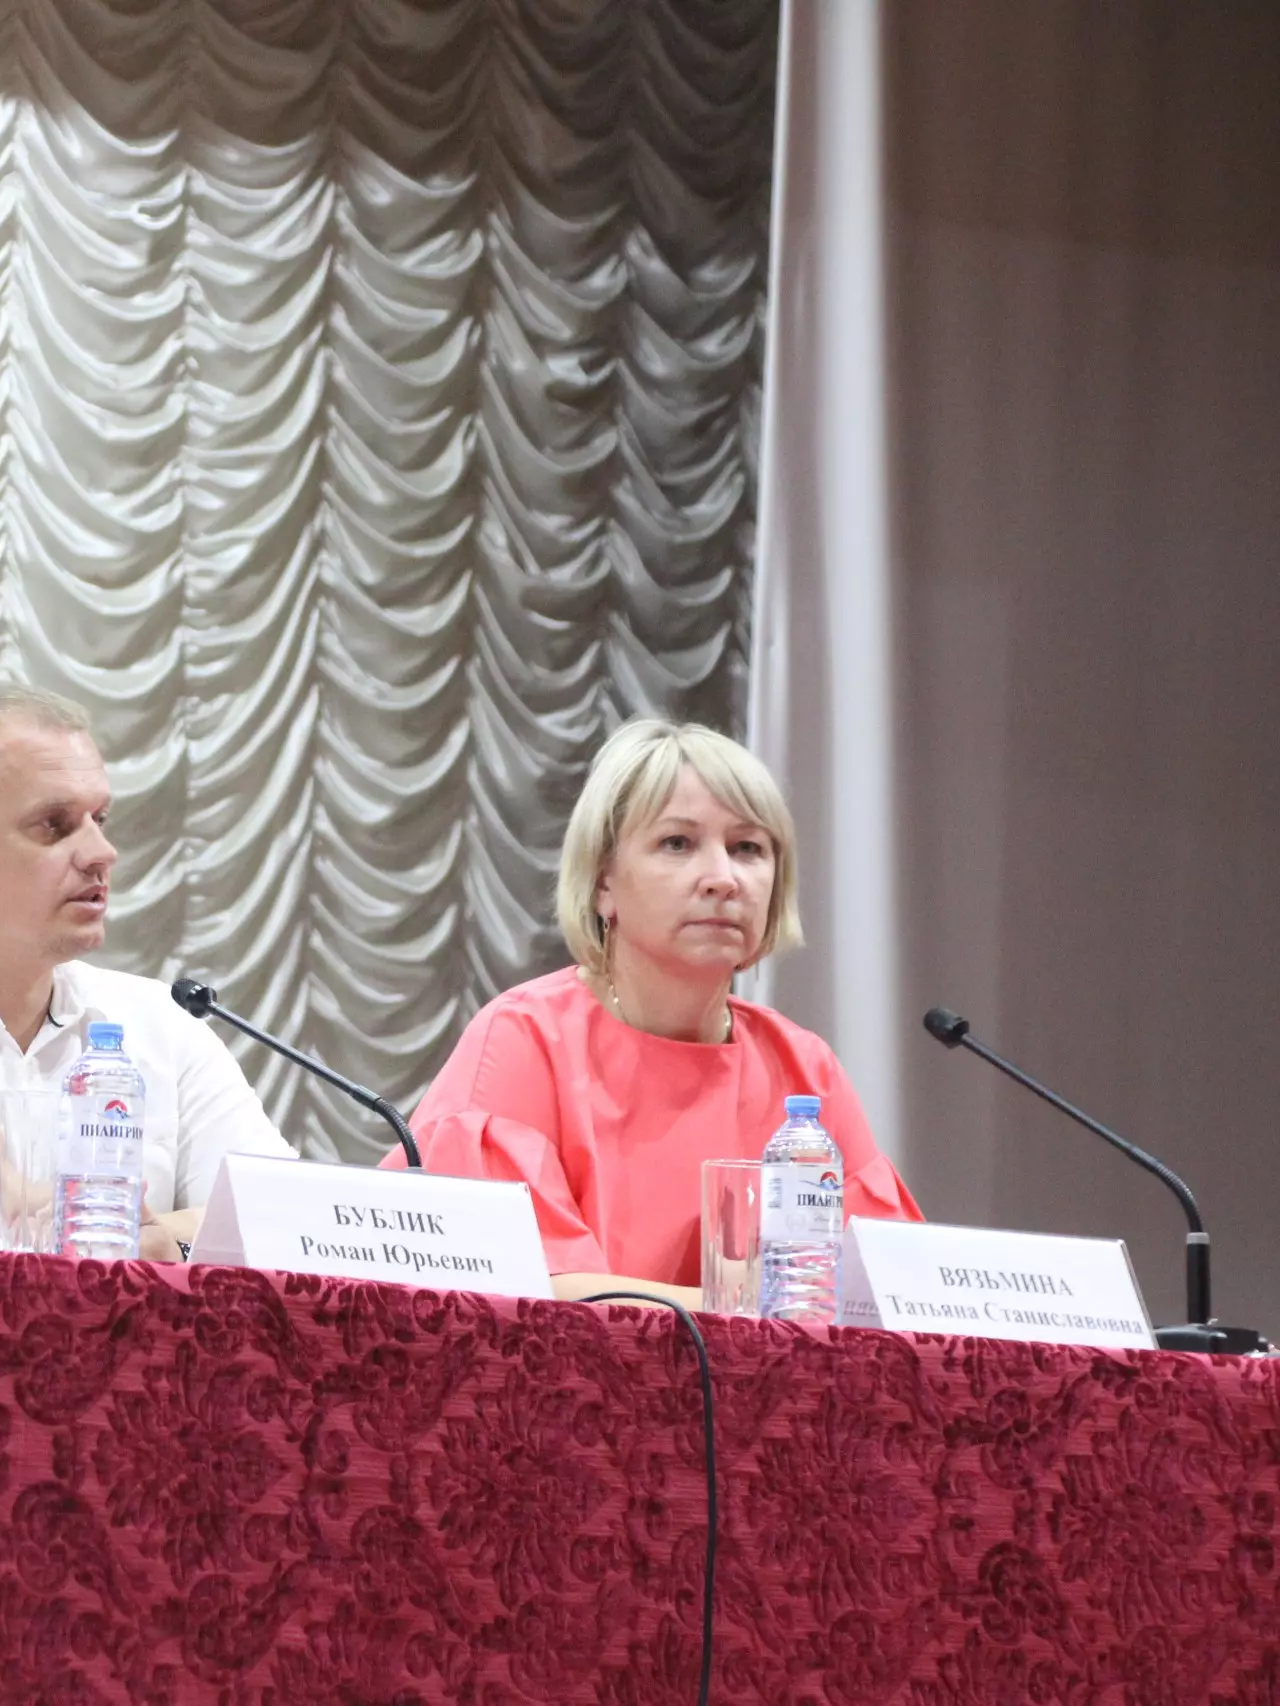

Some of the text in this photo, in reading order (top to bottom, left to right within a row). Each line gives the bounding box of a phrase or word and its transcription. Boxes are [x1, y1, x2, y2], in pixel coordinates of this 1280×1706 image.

[333, 1204, 445, 1236] БУБЛИК
[299, 1235, 494, 1274] Роман Юрьевич
[938, 1266, 1074, 1297] ВЯЗЬМИНА
[886, 1294, 979, 1321] Татьяна
[983, 1301, 1145, 1335] Станиславовна
